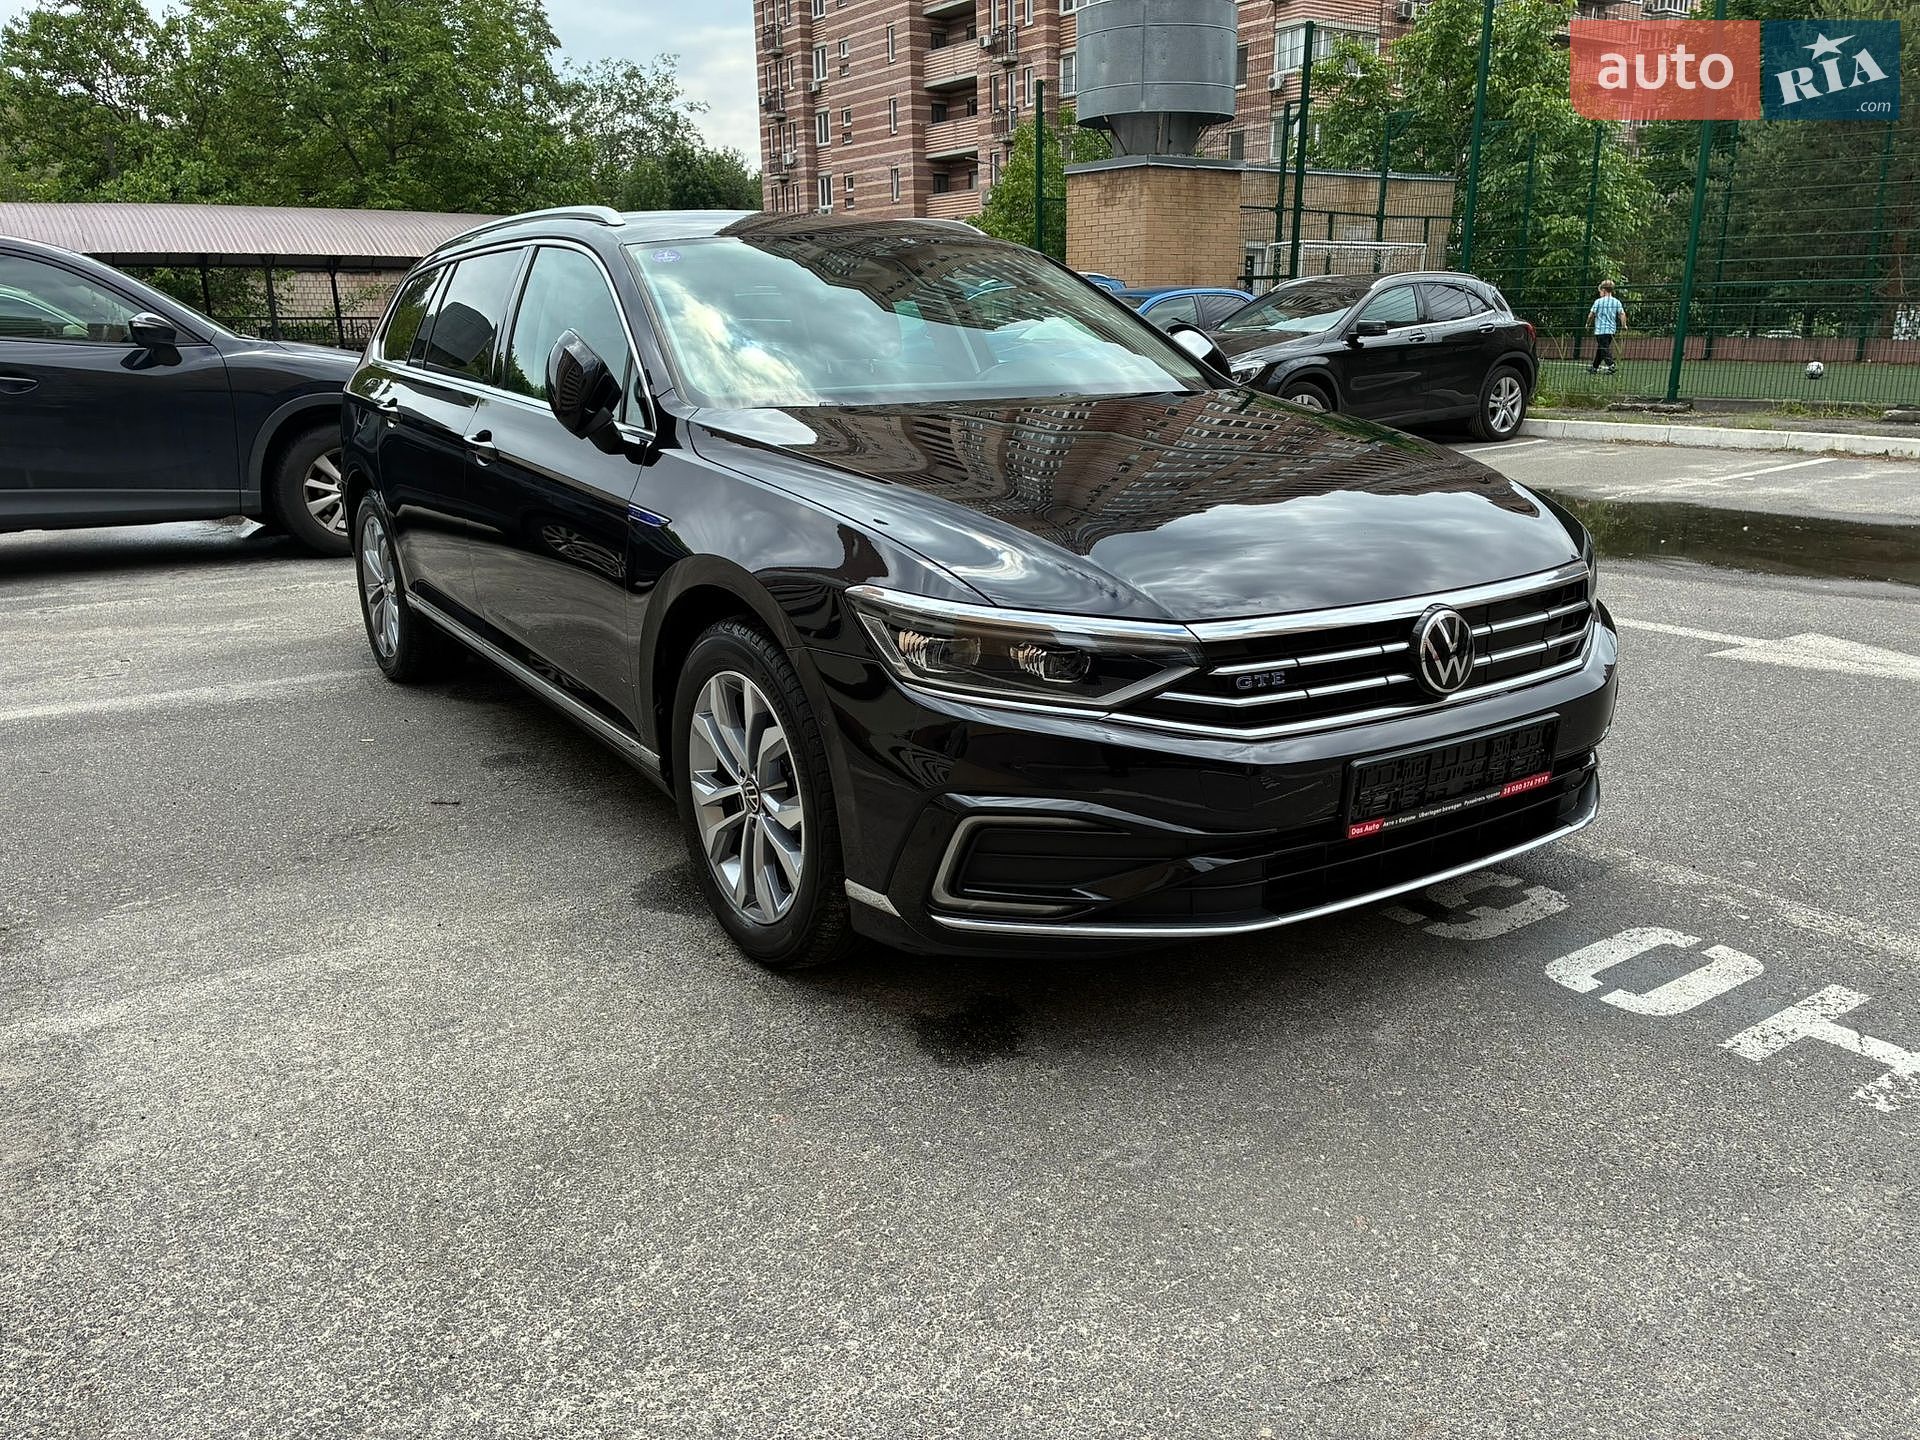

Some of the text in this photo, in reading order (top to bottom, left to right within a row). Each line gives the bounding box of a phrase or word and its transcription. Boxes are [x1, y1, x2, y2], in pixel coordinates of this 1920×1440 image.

[1236, 671, 1286, 689] GTE
[1351, 823, 1379, 836] Das Auto
